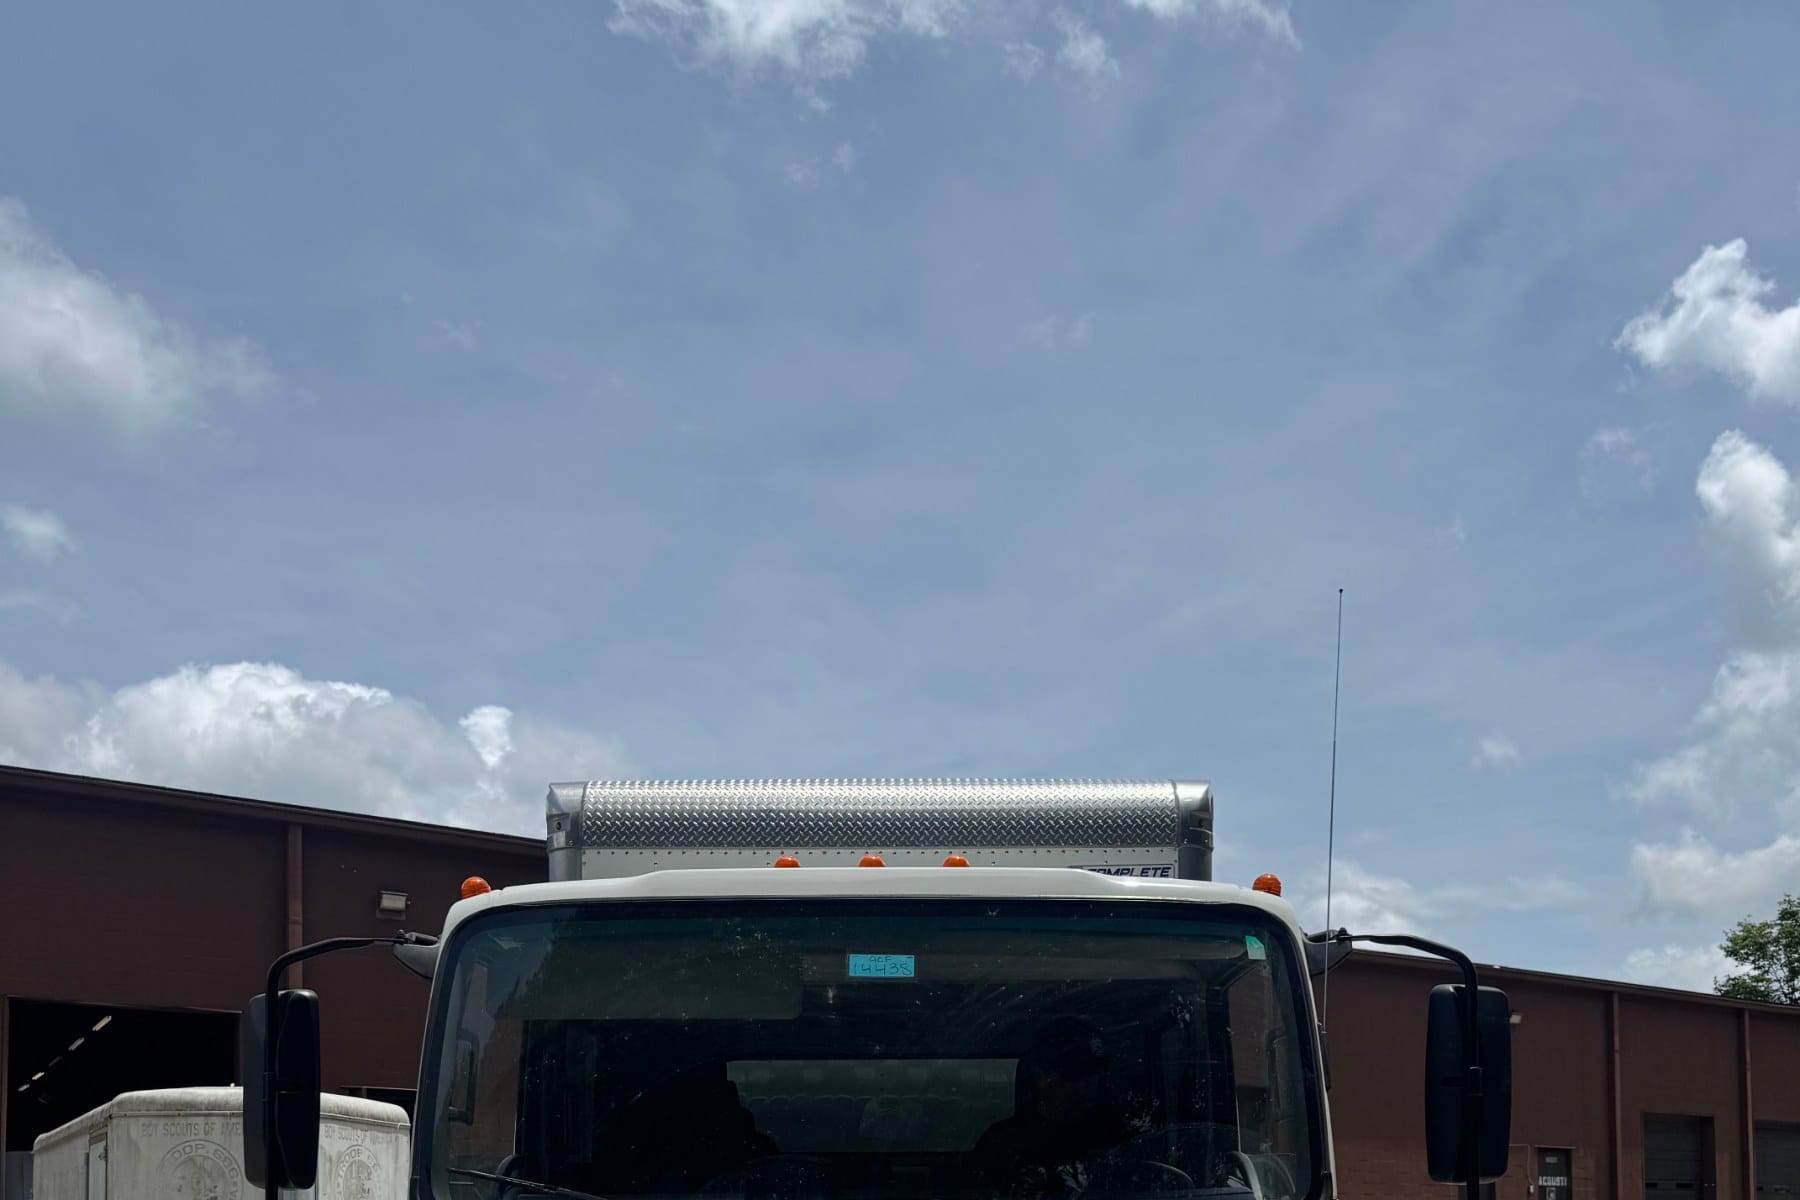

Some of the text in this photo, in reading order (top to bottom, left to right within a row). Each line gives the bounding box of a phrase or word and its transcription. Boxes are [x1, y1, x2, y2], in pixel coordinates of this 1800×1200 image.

[1087, 866, 1172, 878] OMPLETE
[854, 961, 913, 977] 14438
[162, 1122, 200, 1137] SCOUTS
[203, 1122, 217, 1137] OF
